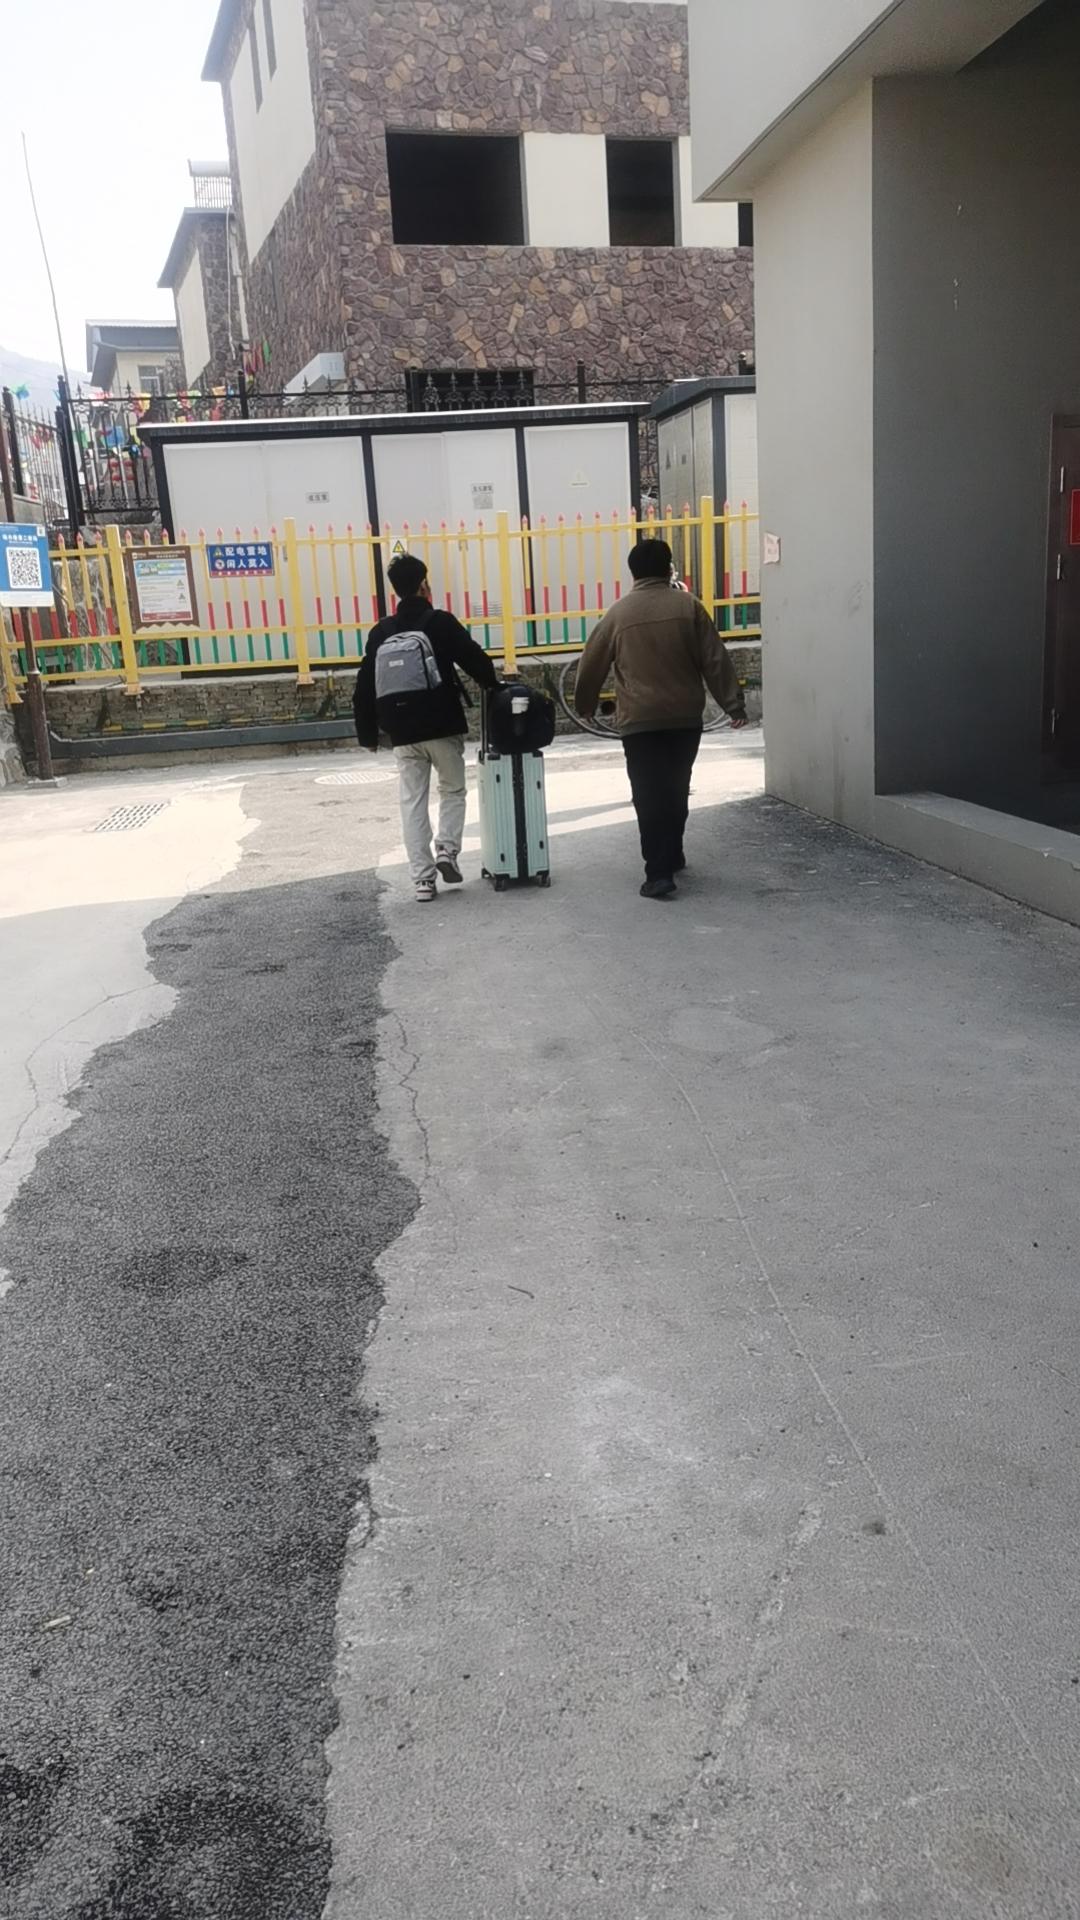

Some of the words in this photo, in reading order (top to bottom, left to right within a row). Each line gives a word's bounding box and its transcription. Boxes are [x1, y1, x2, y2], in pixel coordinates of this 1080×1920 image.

[225, 546, 267, 556] 配电重地
[227, 558, 268, 568] 闲人莫入
